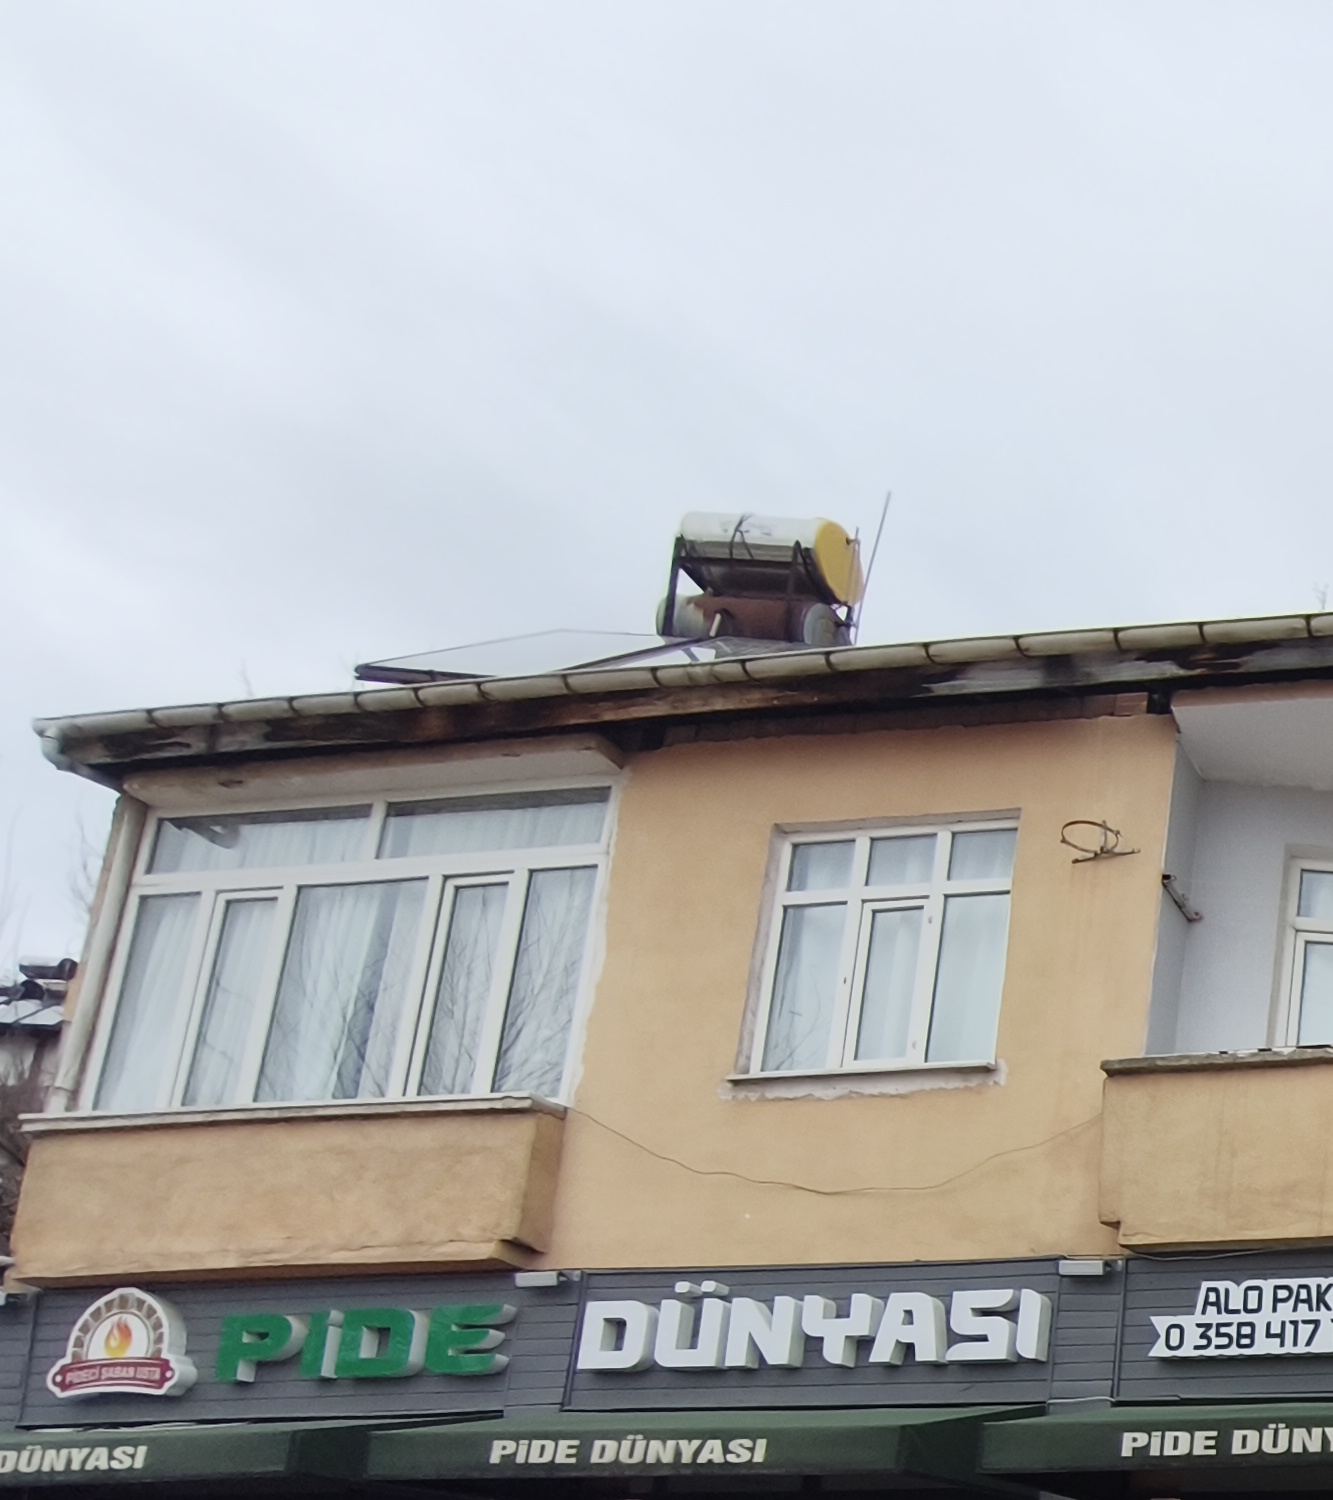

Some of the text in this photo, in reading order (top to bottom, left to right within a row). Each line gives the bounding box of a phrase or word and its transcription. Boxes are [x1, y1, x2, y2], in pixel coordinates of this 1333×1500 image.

[1201, 1285, 1263, 1315] ALO
[577, 1280, 1053, 1372] DÜNYASI
[1164, 1323, 1185, 1351] 0
[1193, 1321, 1254, 1350] 358
[1265, 1320, 1318, 1348] 417
[590, 1435, 767, 1465] DÜNYASI
